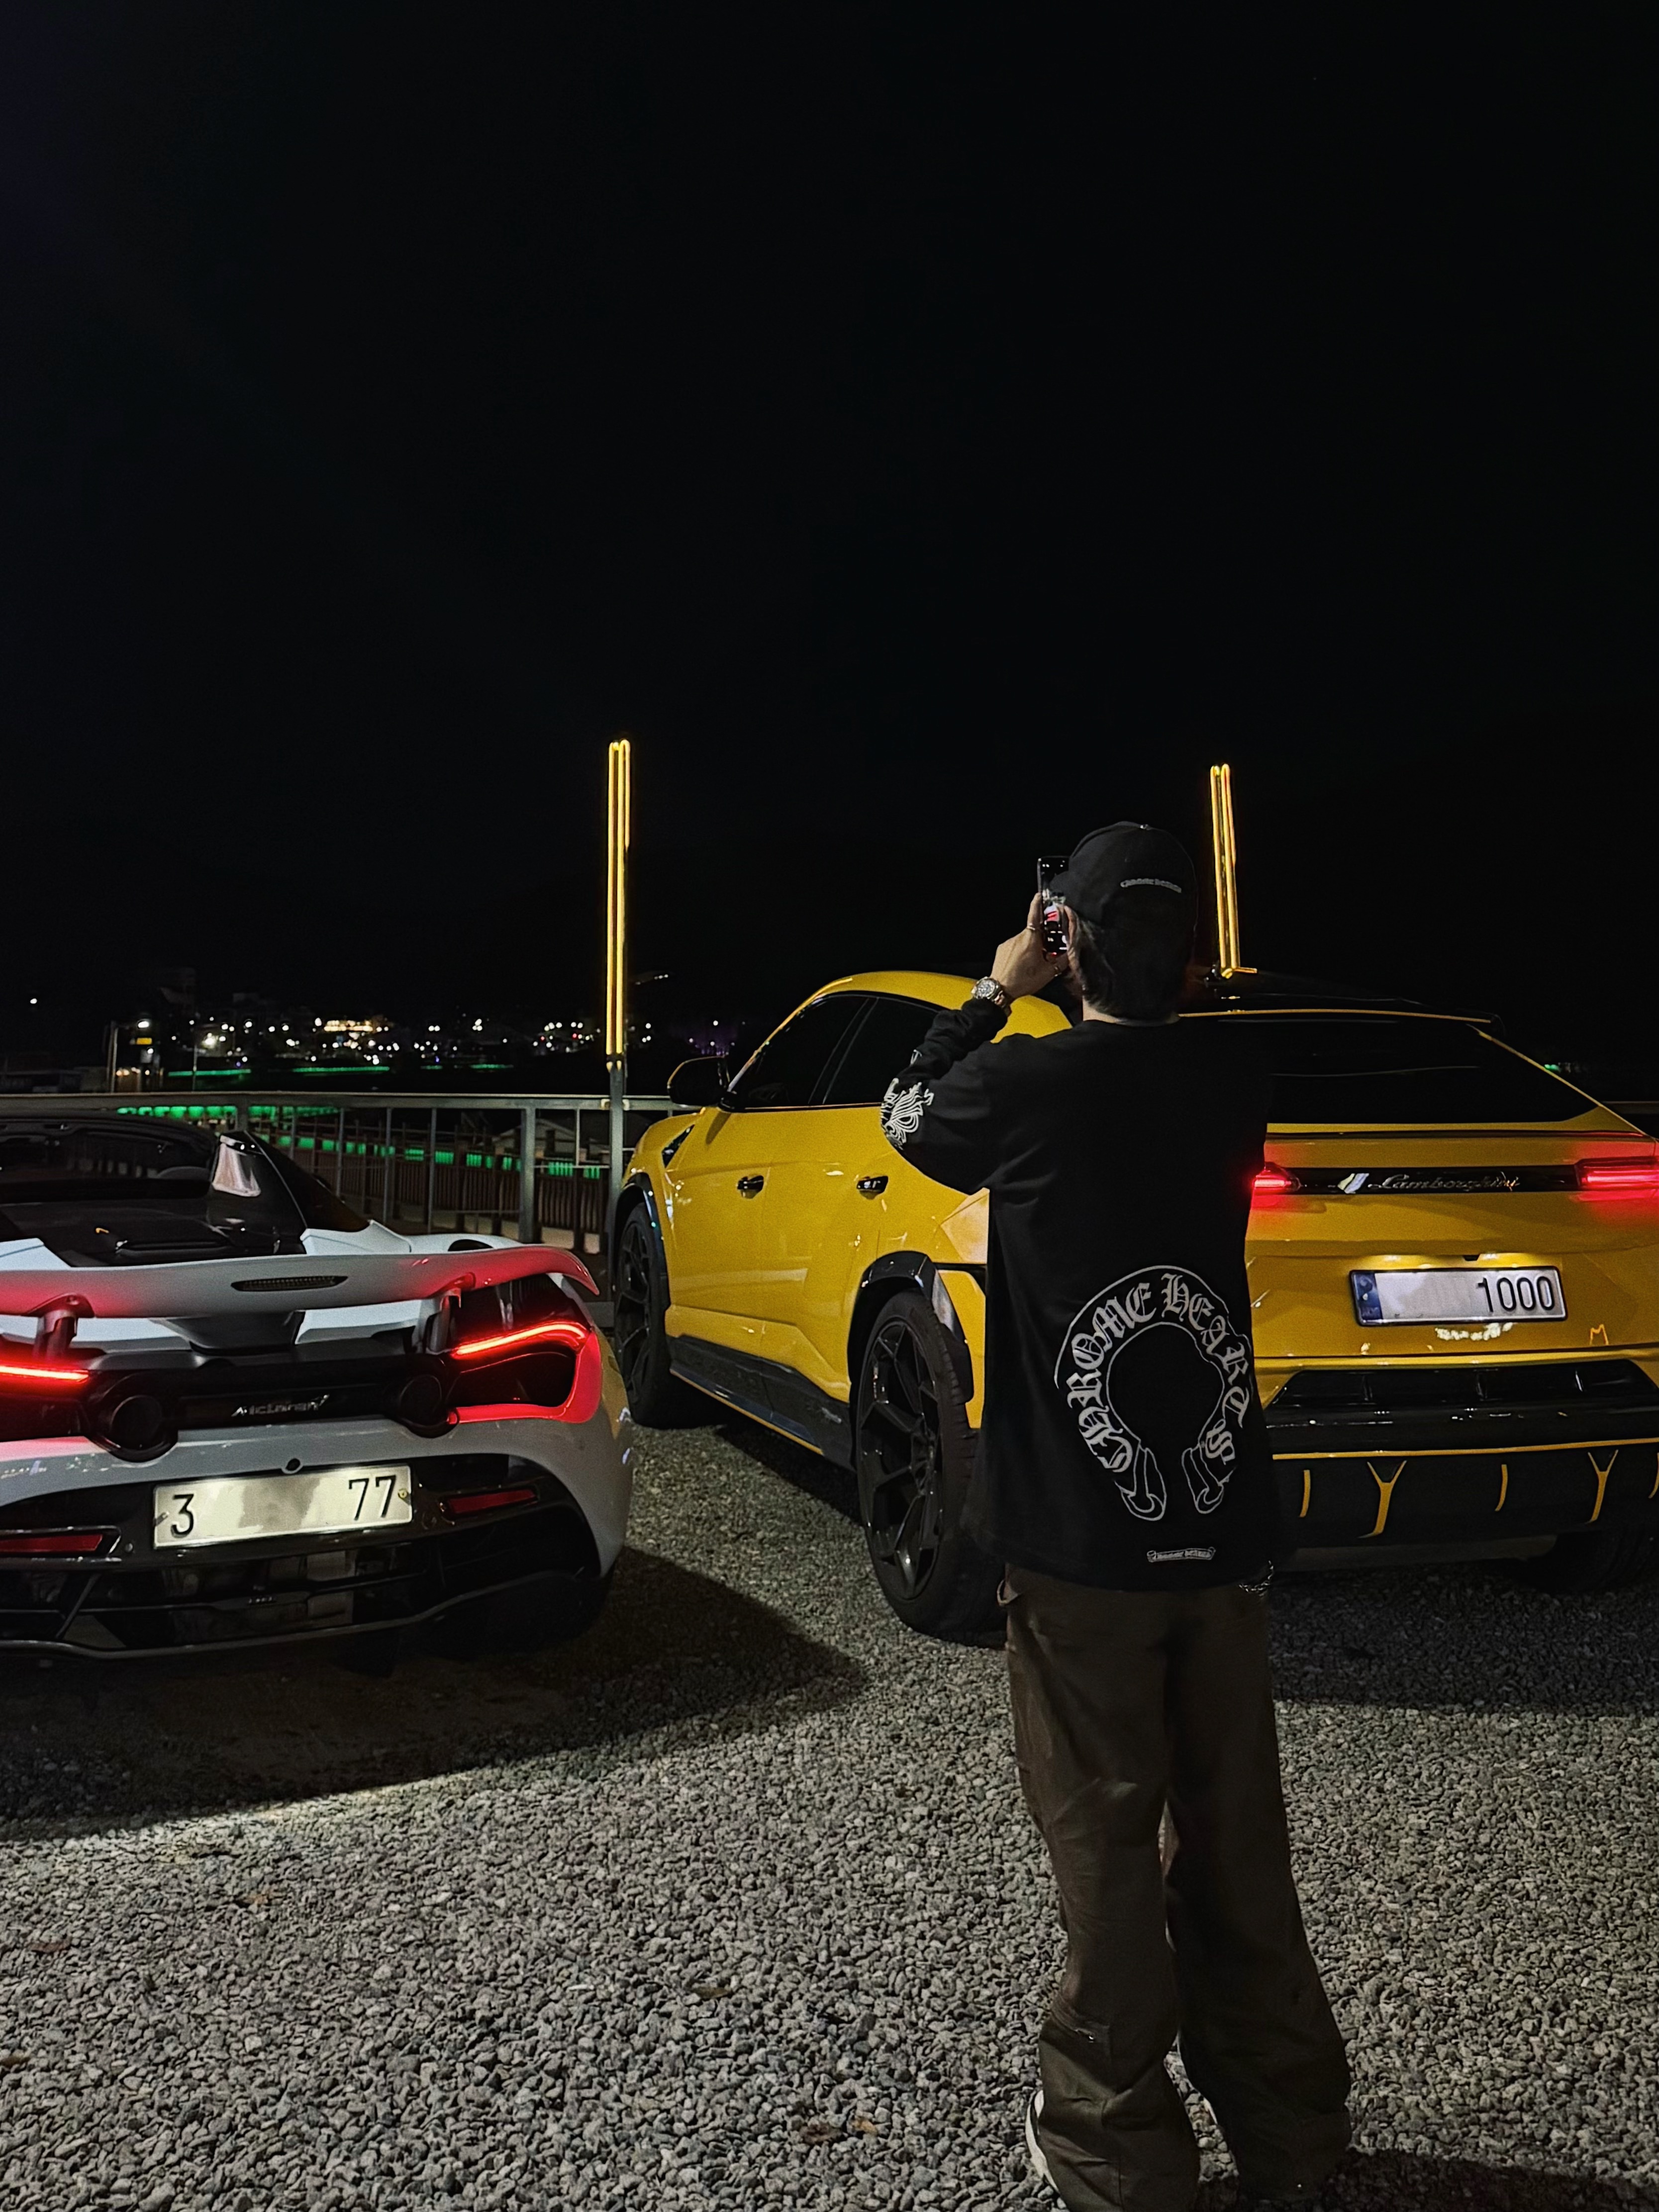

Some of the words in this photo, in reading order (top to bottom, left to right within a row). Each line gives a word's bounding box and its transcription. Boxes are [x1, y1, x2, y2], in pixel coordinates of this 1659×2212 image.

[1477, 1276, 1555, 1312] 1000
[171, 1493, 194, 1538] 3
[348, 1475, 396, 1521] 77
